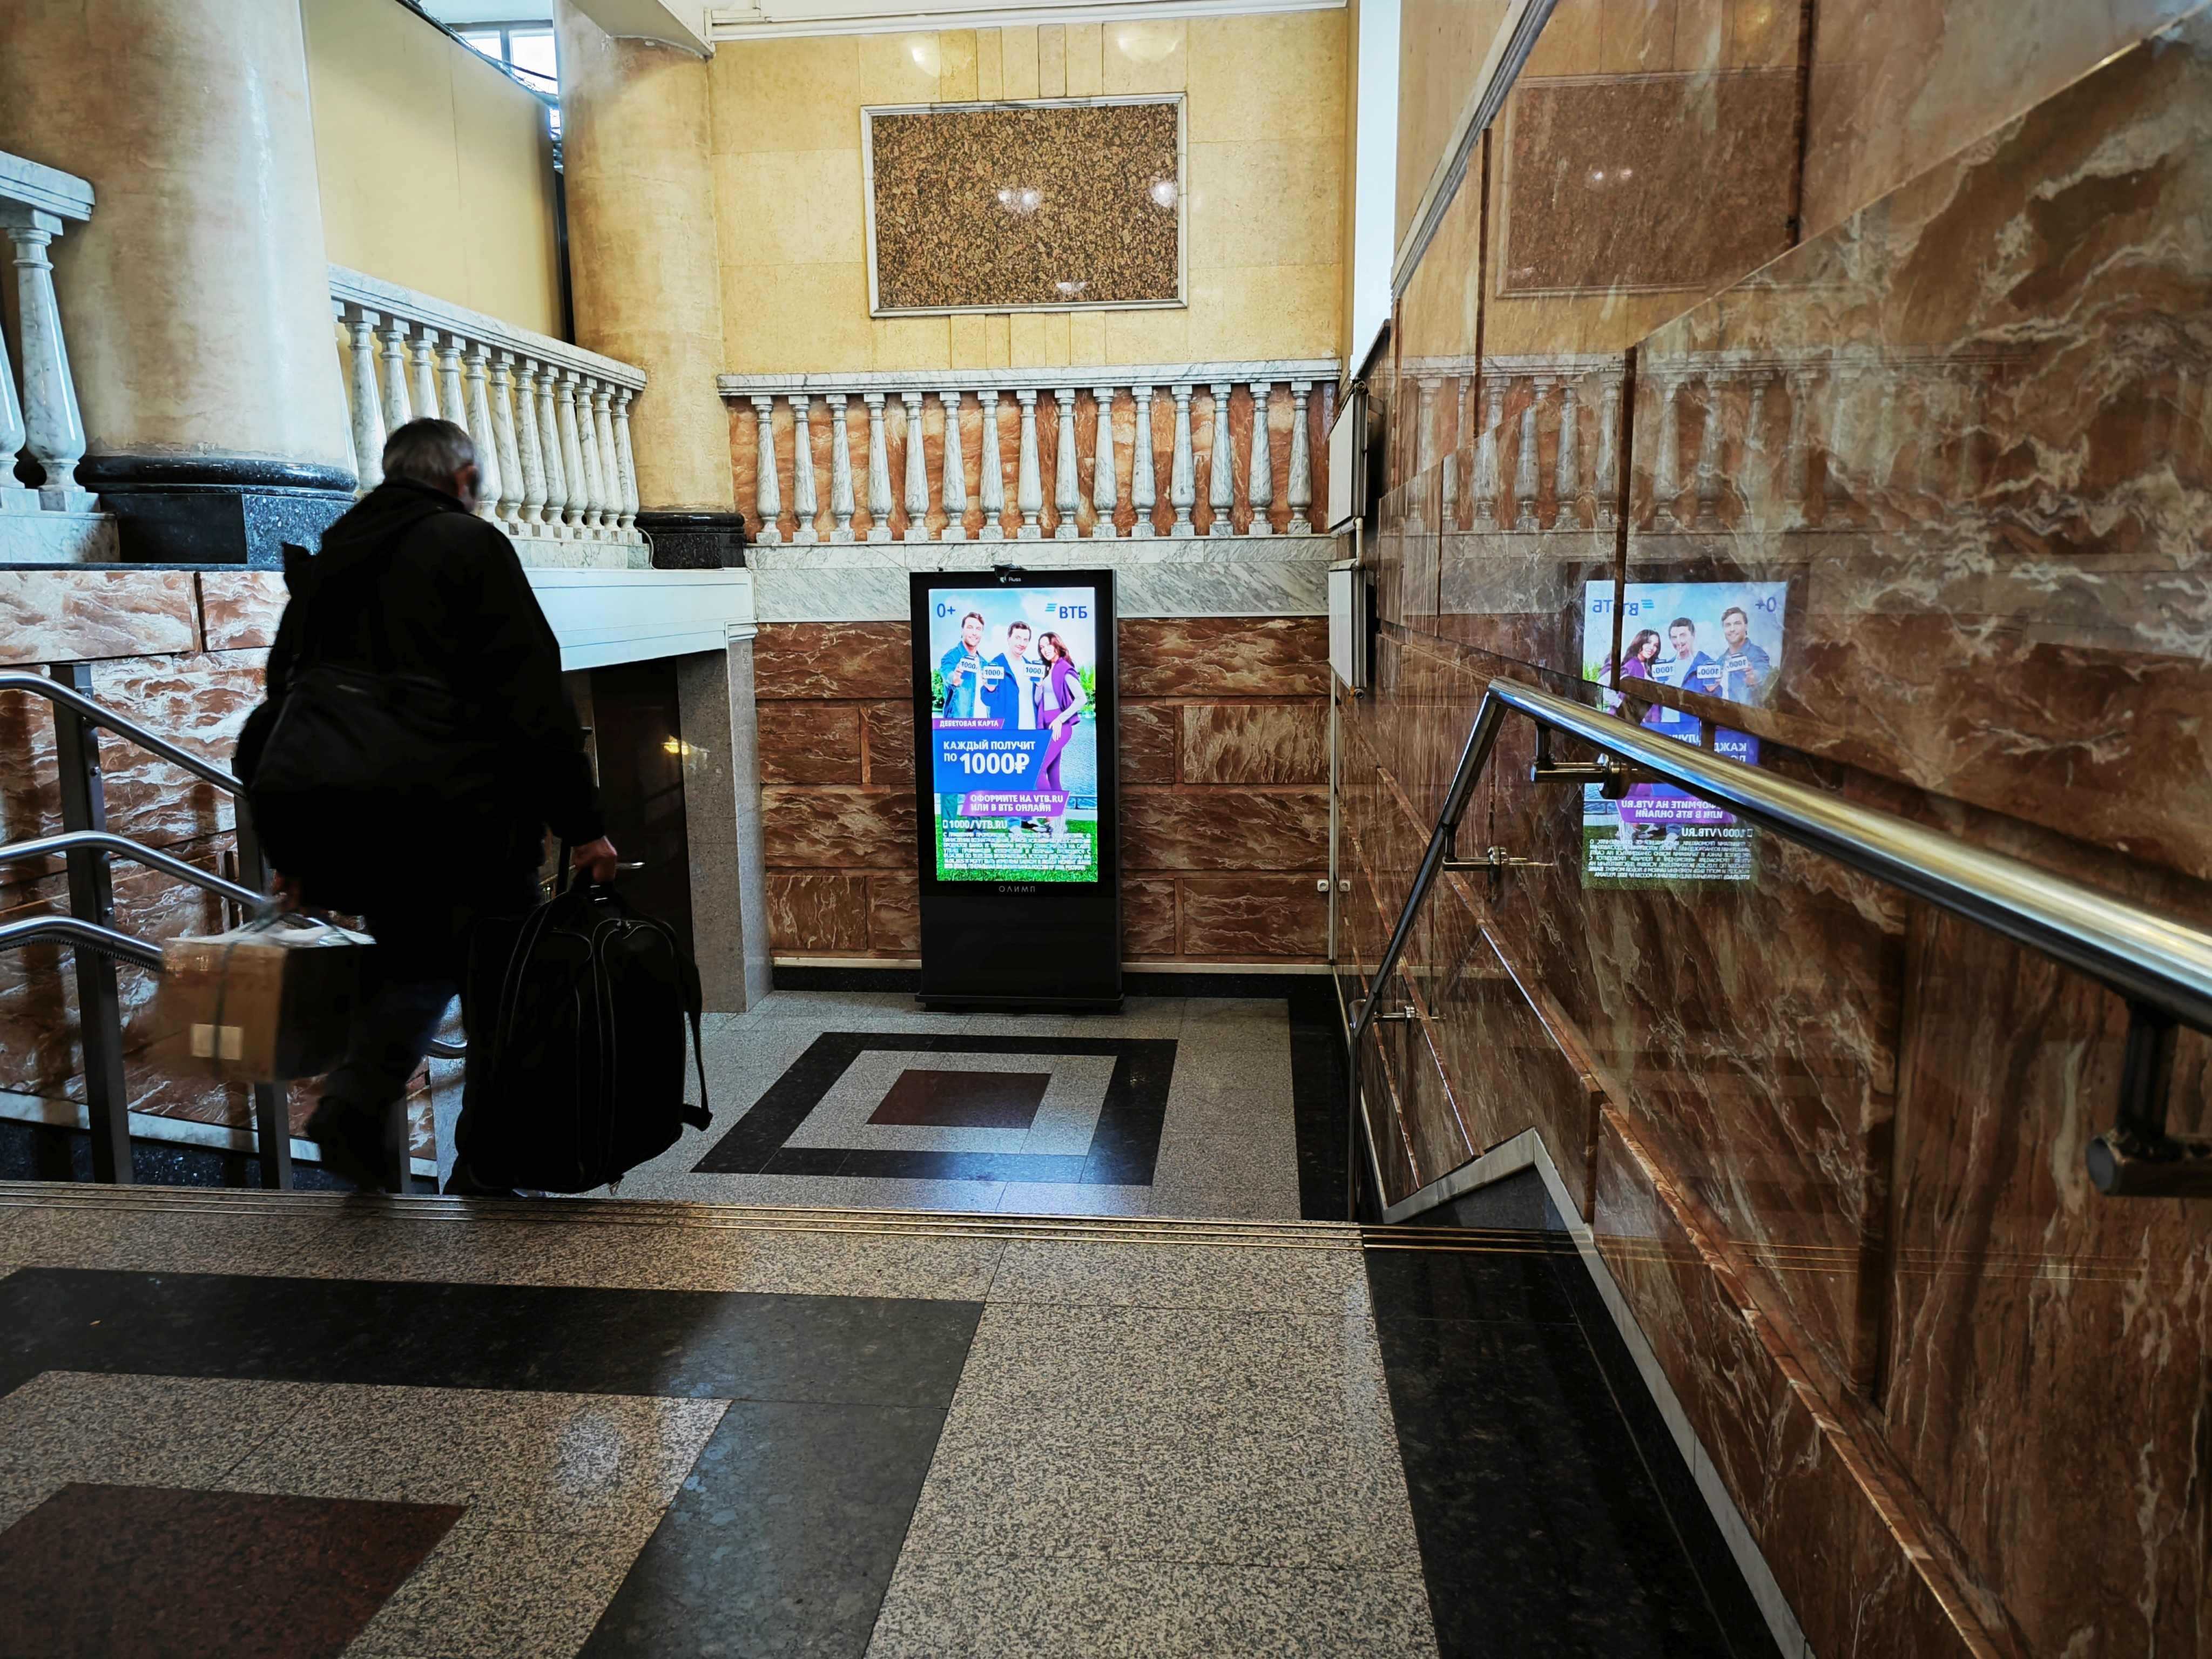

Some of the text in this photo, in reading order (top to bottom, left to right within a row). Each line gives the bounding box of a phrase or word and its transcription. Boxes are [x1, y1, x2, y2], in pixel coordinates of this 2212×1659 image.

[936, 603, 956, 618] 0+
[1059, 606, 1088, 619] ВТБ
[943, 739, 1036, 751] КАЖДЫЙ ПОЛУЧИТ
[944, 753, 1030, 774] ПО 1000₽
[970, 794, 1063, 803] ОФОРМИТЕ НА VTB.RU
[970, 804, 989, 812] ИЛИ
[999, 804, 1014, 812] ВТБ
[1016, 803, 1051, 813] ОНЛАЙН
